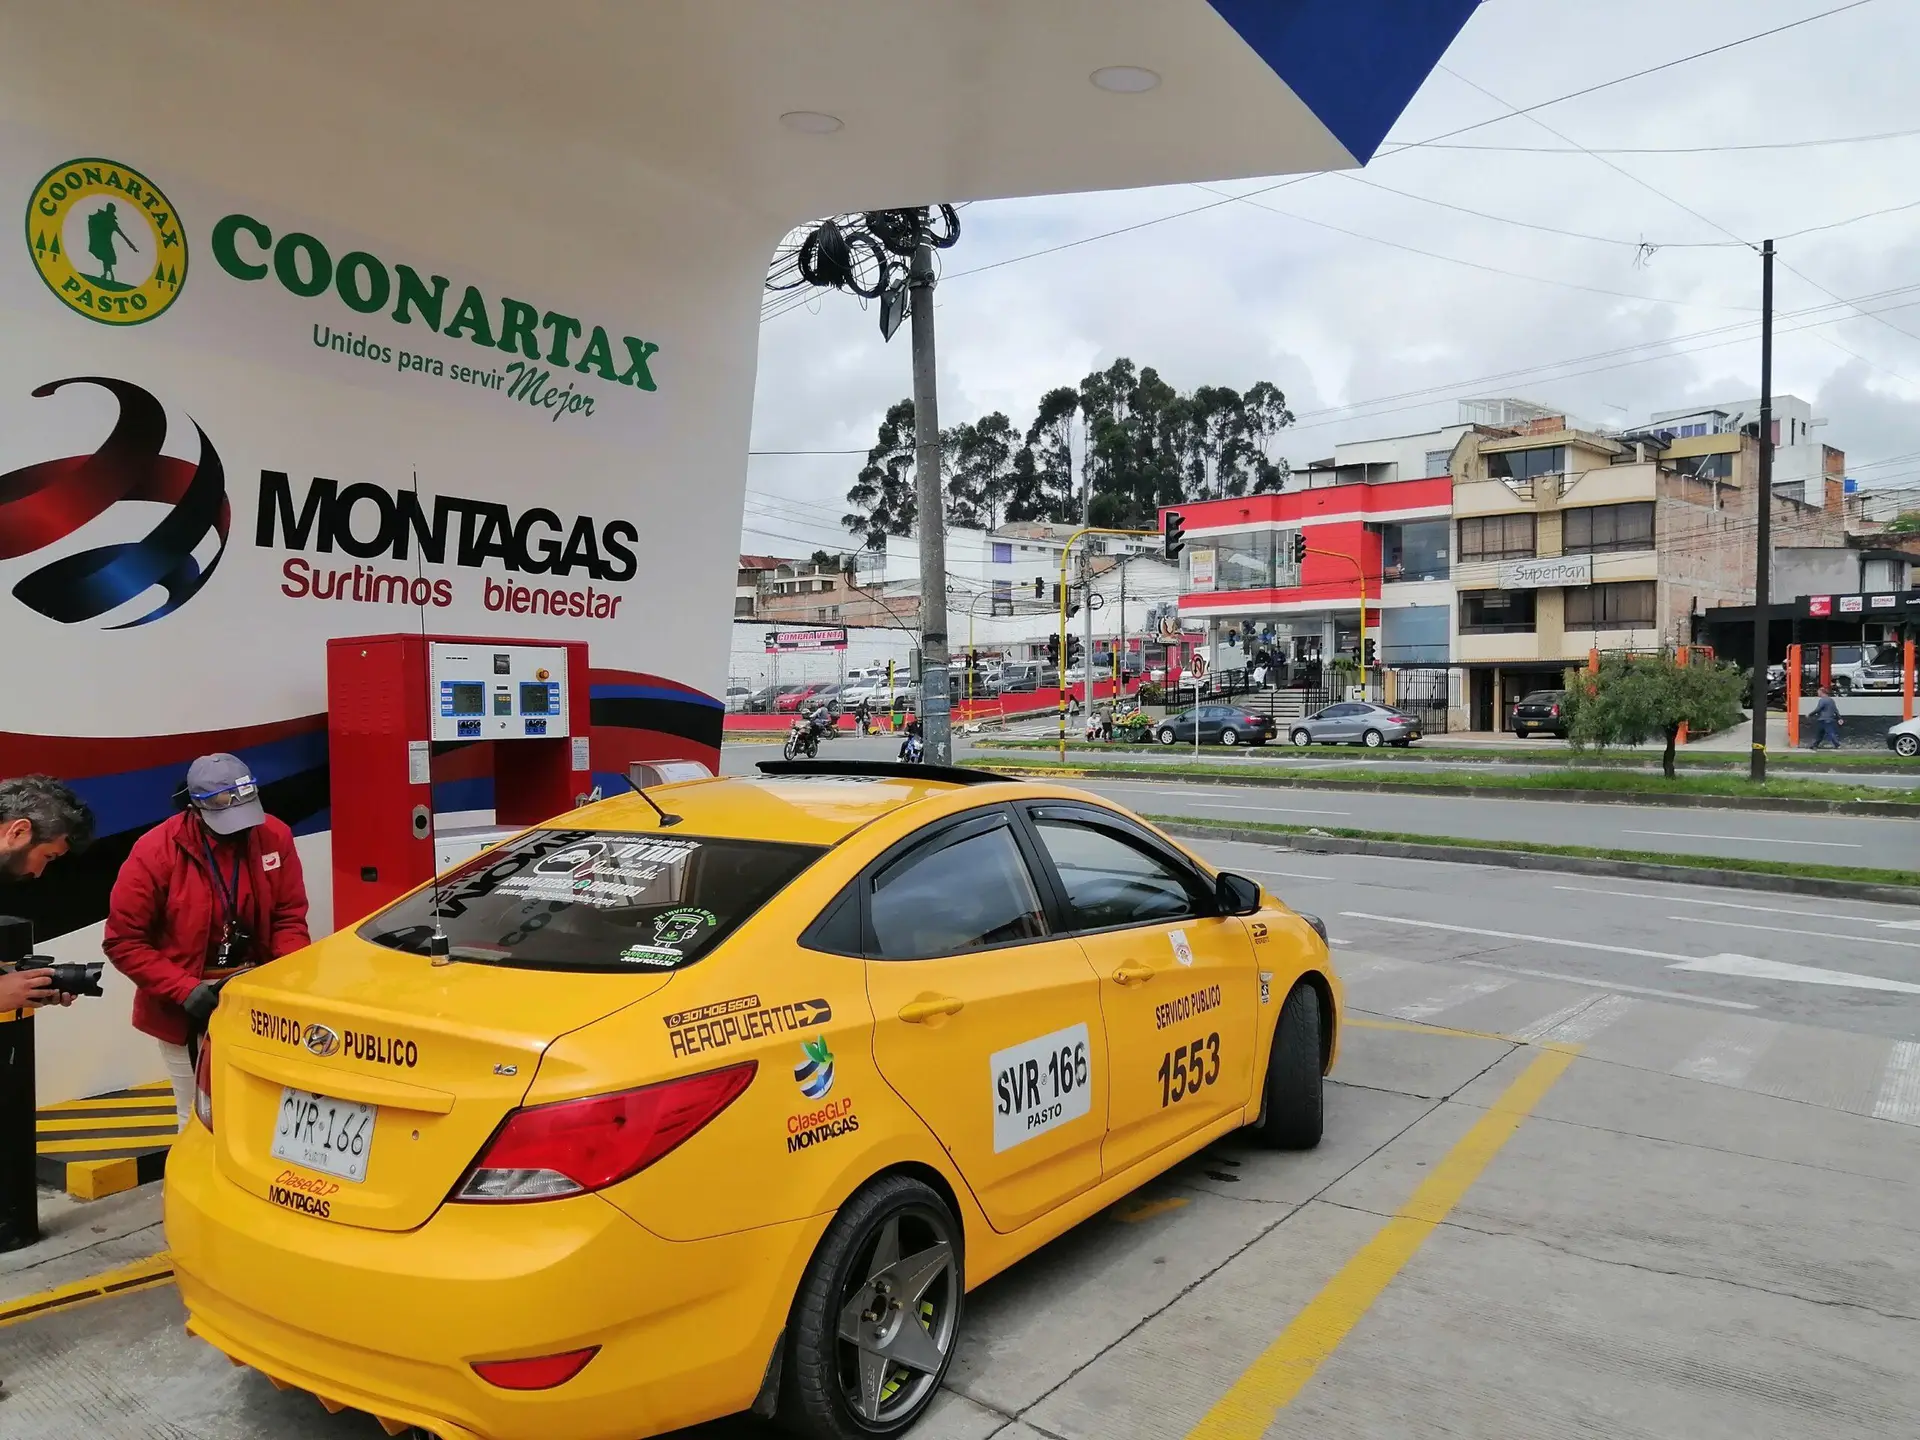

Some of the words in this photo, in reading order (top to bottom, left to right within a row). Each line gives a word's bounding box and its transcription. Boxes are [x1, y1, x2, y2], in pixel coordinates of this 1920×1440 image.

[39, 167, 180, 249] COONARTAX
[61, 275, 147, 315] PASTO
[211, 213, 659, 392] COONARTAX
[313, 323, 392, 364] Unidos
[397, 349, 444, 377] para
[449, 363, 505, 391] servir
[505, 361, 595, 423] Mejor
[254, 469, 639, 582] MONTAGAS
[281, 557, 453, 608] Surtimos
[483, 576, 622, 619] bienestar
[1514, 564, 1585, 584] SuperPan
[777, 632, 815, 642] COMPRA
[815, 631, 843, 639] VENTA
[682, 1008, 703, 1024] 301
[703, 1003, 727, 1017] 406
[1155, 994, 1190, 1031] SERVICIO
[1191, 984, 1221, 1017] PUBLICO
[250, 1008, 301, 1046] SERVICIO
[343, 1030, 418, 1068] PUBLICO
[669, 1004, 797, 1058] AEROPUERTO
[1157, 1031, 1221, 1109] 1553
[786, 1115, 860, 1154] MONTAGAS
[787, 1097, 852, 1134] ClaseGLP
[1027, 1102, 1063, 1131] PASTO
[269, 1184, 330, 1219] MONTAGAS
[275, 1169, 340, 1197] ClaseGLP
